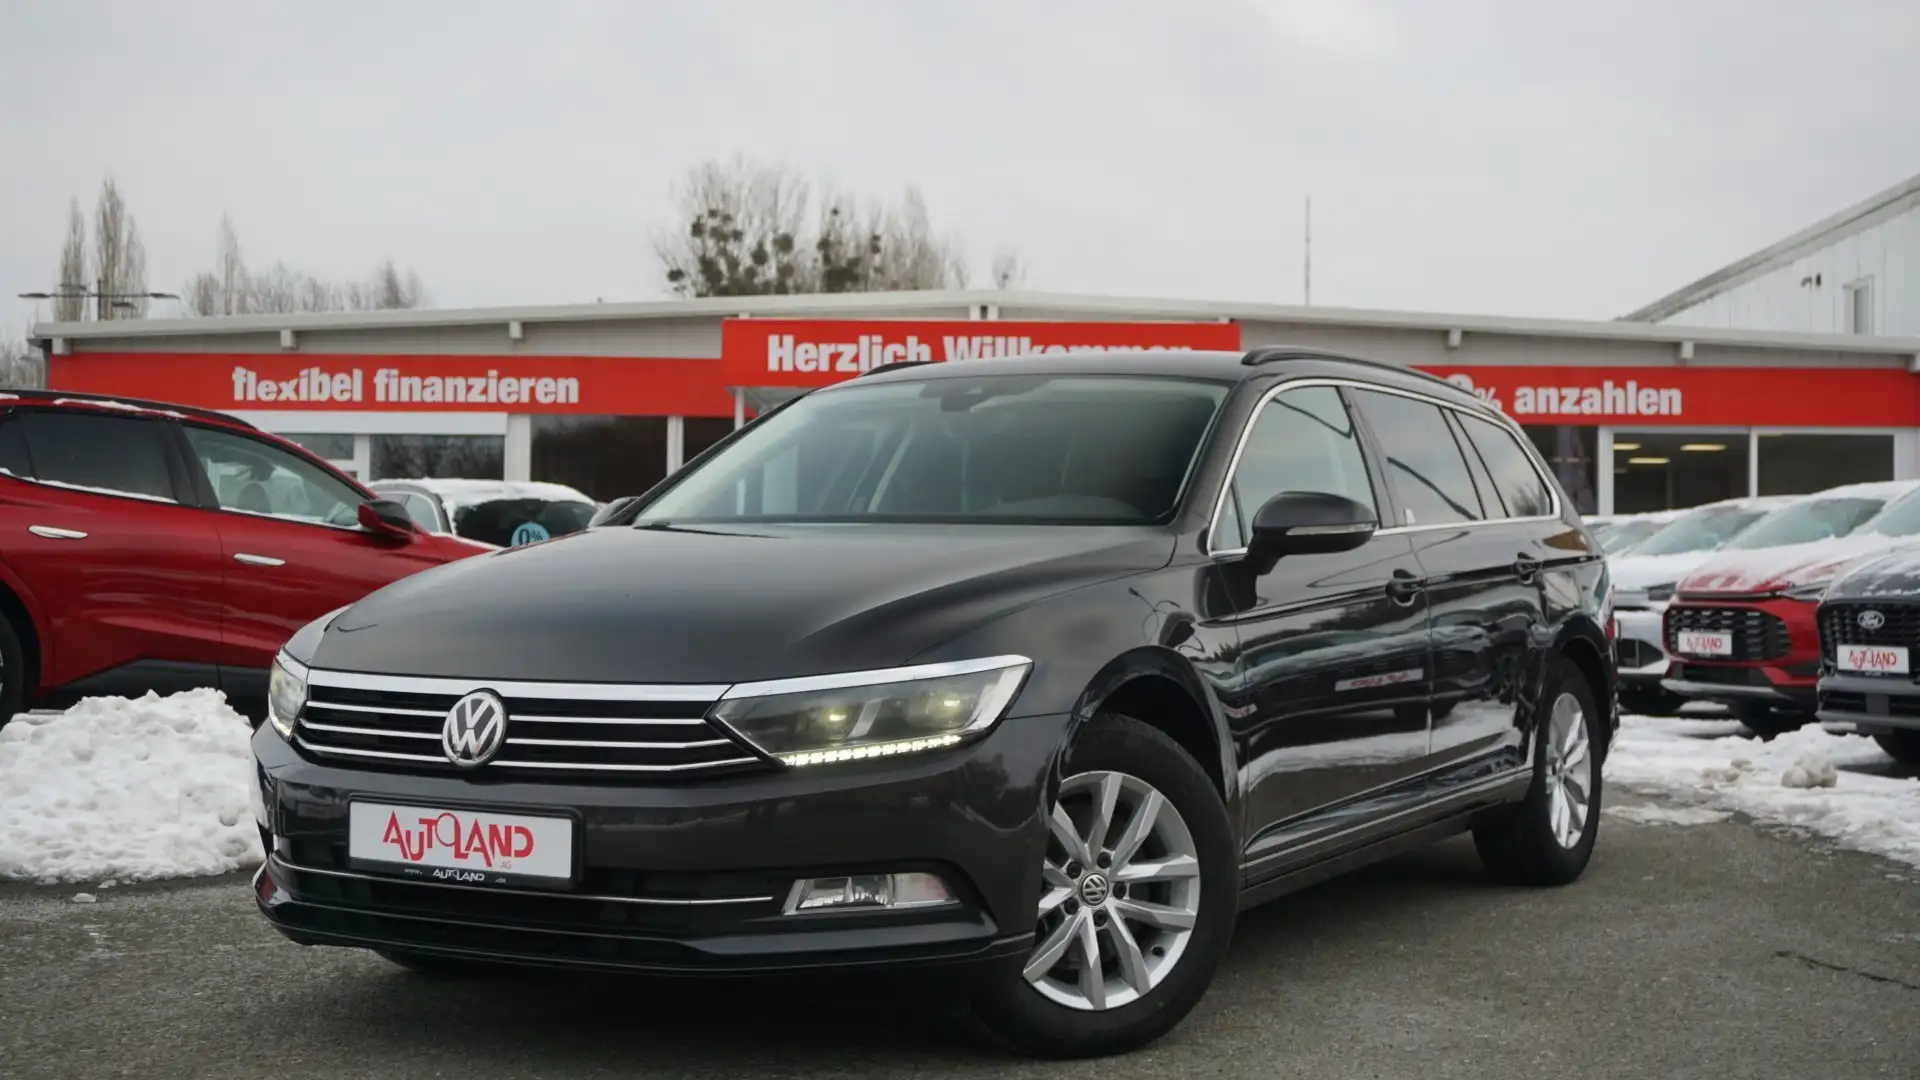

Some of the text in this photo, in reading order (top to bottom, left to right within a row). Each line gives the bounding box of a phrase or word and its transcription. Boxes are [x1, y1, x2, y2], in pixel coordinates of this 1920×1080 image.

[767, 334, 933, 372] Herzlich
[232, 366, 579, 404] flexibel finanzieren
[1514, 380, 1682, 415] anzahlen
